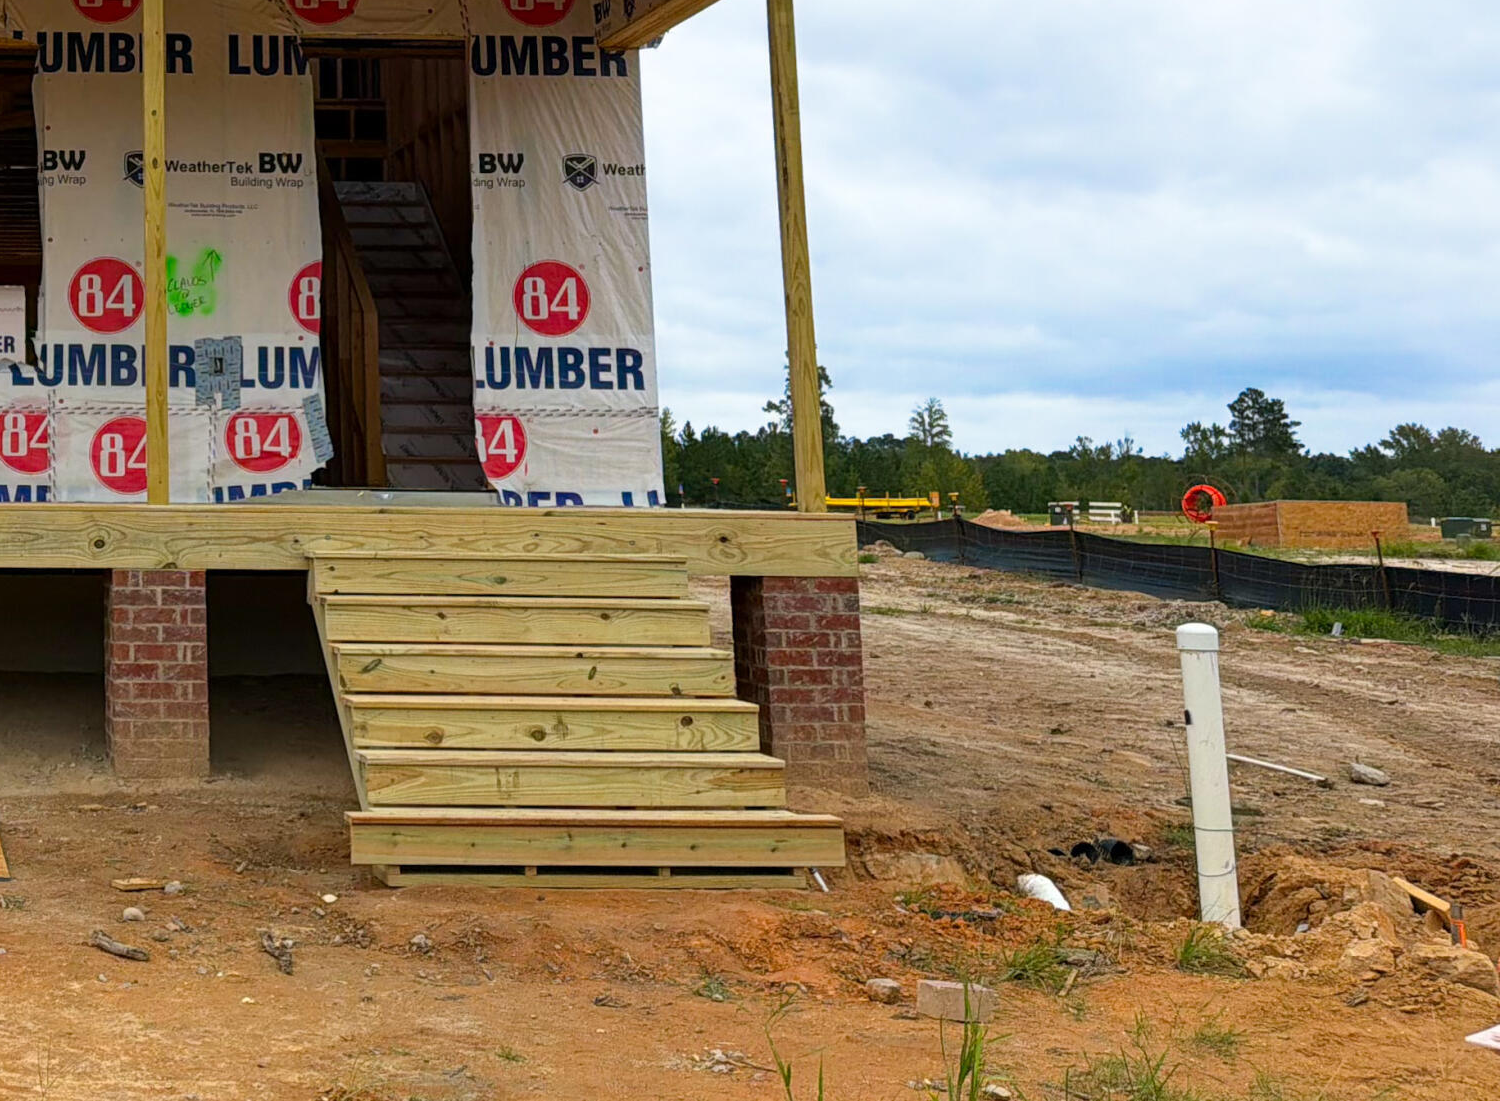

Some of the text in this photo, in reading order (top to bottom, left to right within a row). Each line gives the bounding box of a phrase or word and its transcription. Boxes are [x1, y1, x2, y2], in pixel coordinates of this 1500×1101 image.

[13, 31, 193, 75] UMBR
[43, 150, 86, 171] BW
[165, 153, 302, 175] WeatherTek BW
[479, 153, 524, 174] BW
[57, 175, 87, 186] Wrap
[231, 176, 303, 189] Building Wrap
[497, 177, 525, 189] Wrap
[78, 274, 136, 317] 84
[522, 277, 580, 320] 84
[10, 343, 195, 388] LUMBR
[235, 417, 291, 459] 84
